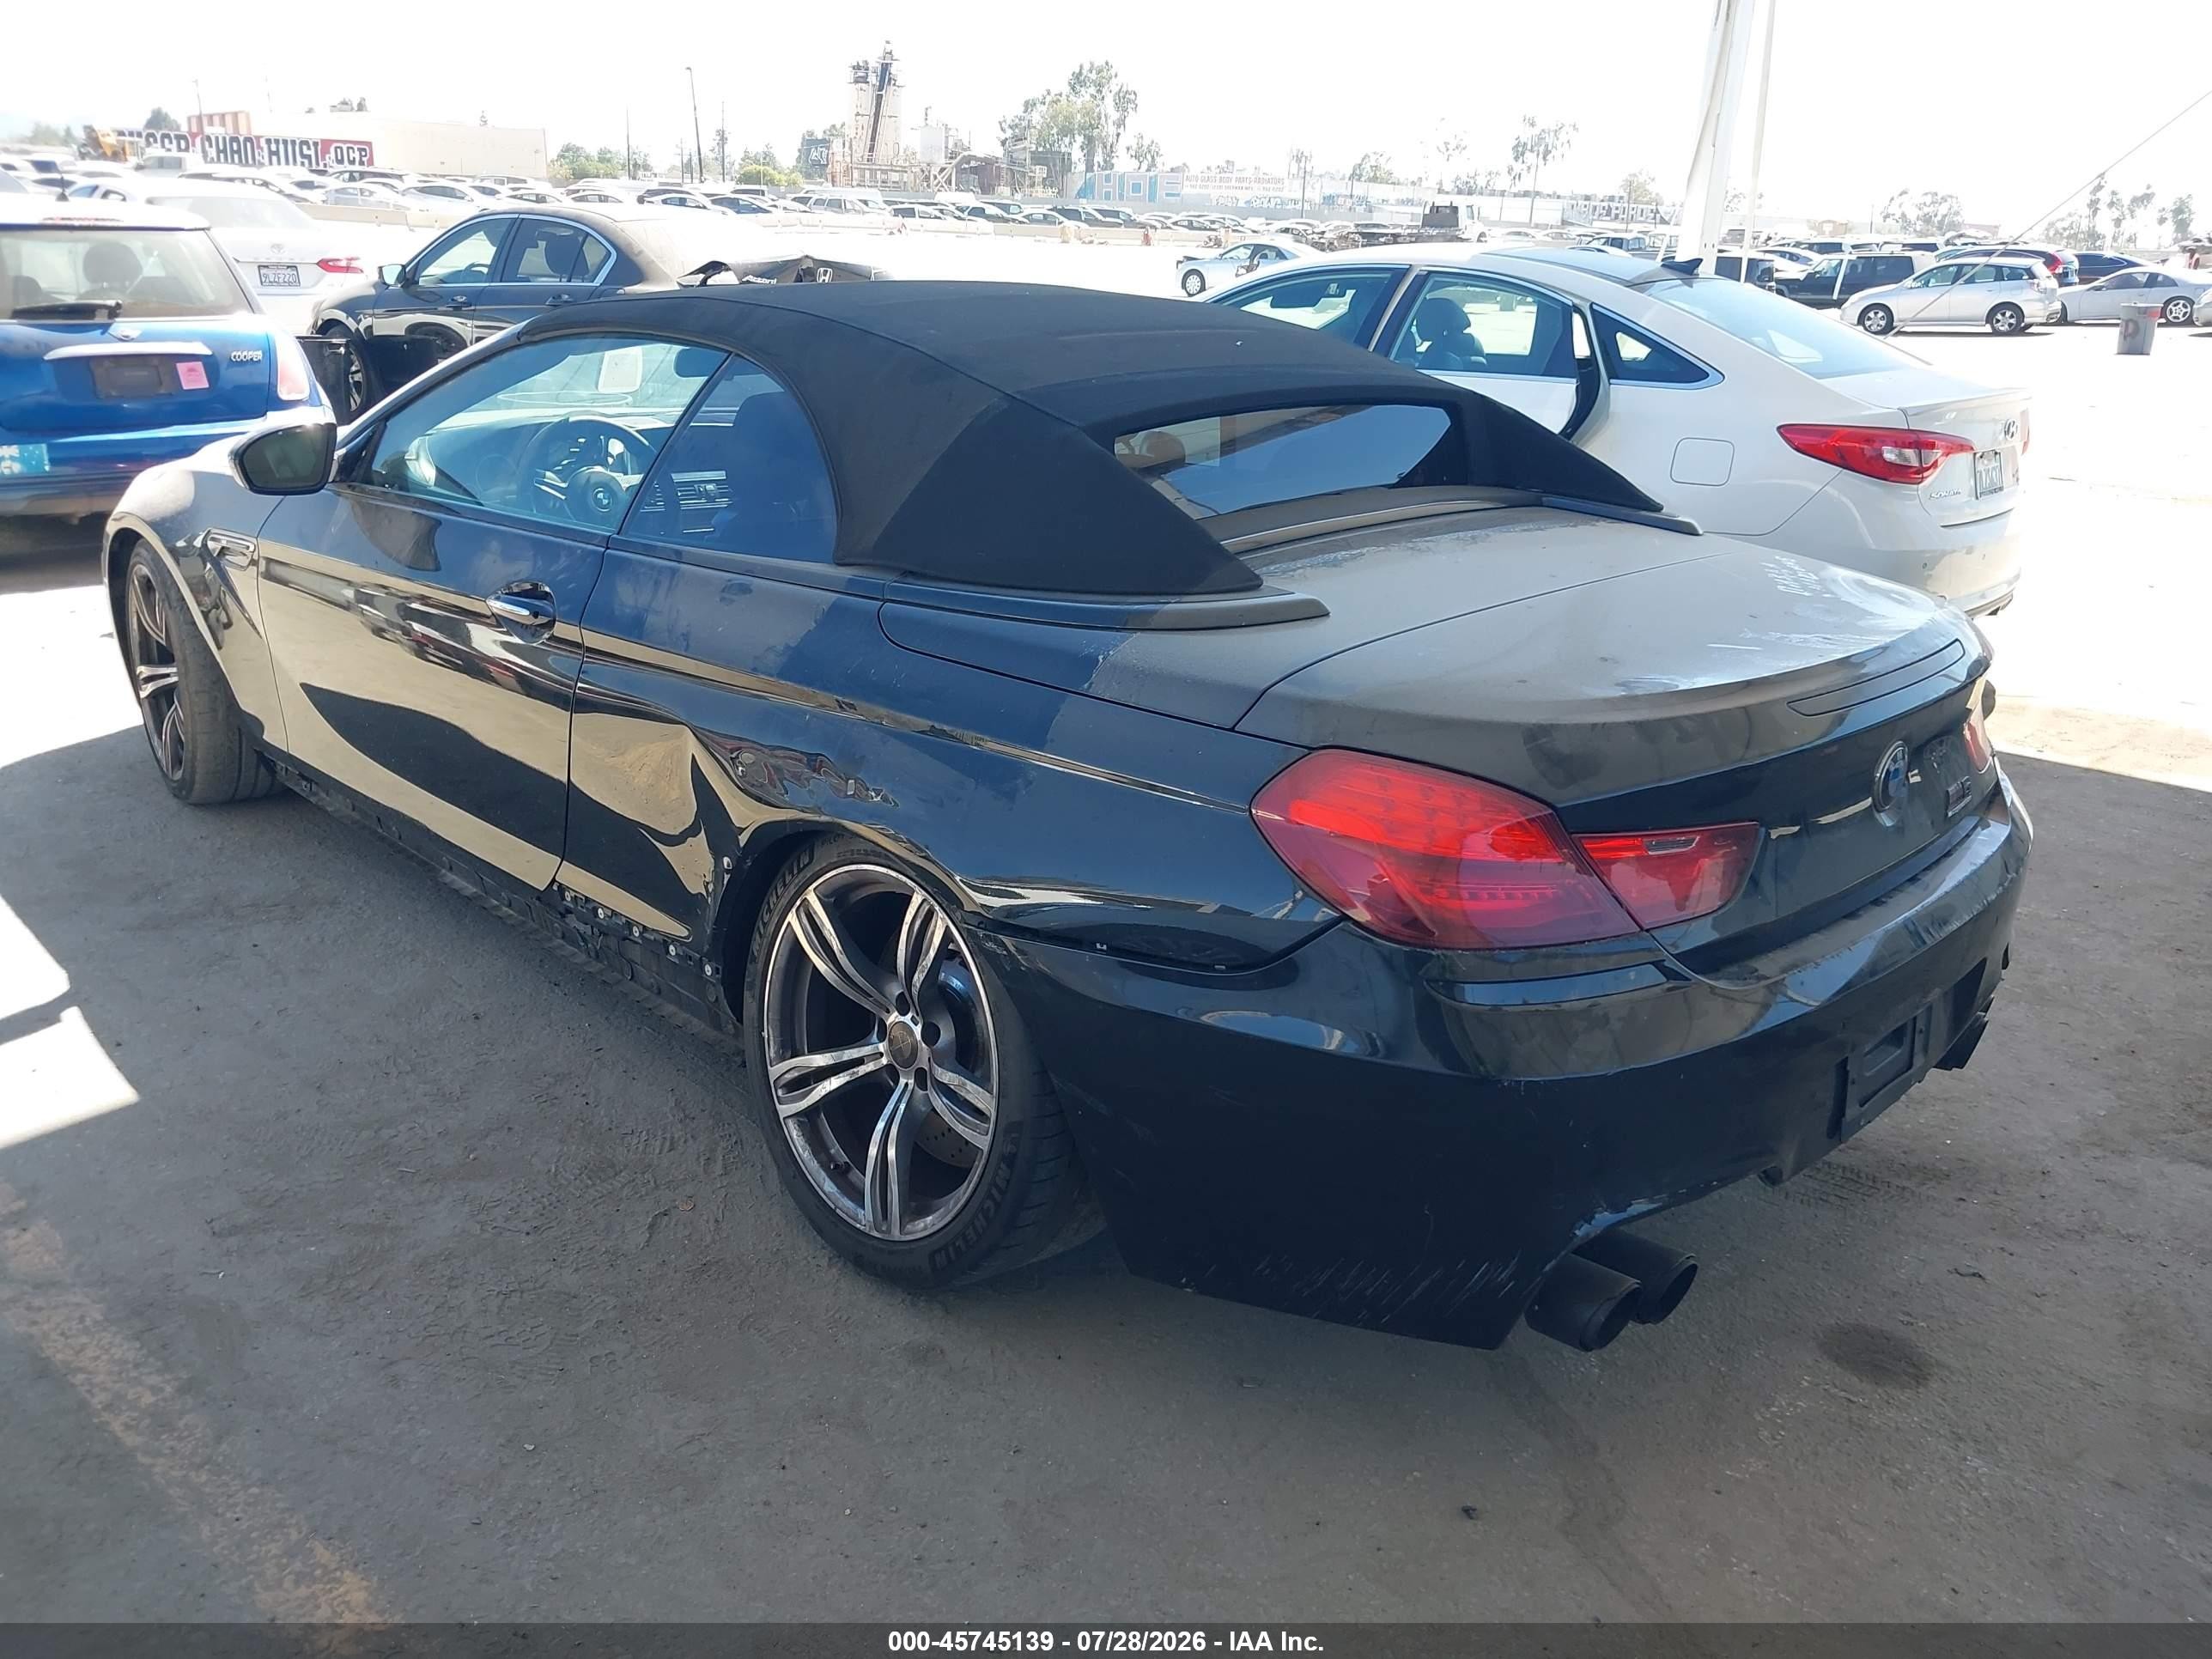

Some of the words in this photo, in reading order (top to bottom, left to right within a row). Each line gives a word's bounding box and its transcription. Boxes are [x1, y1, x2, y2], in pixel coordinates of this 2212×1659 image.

[1200, 175, 1217, 184] GLASS
[231, 349, 263, 362] COOPER
[752, 848, 810, 960] MICHELIN
[934, 1161, 1012, 1269] MICHELIN
